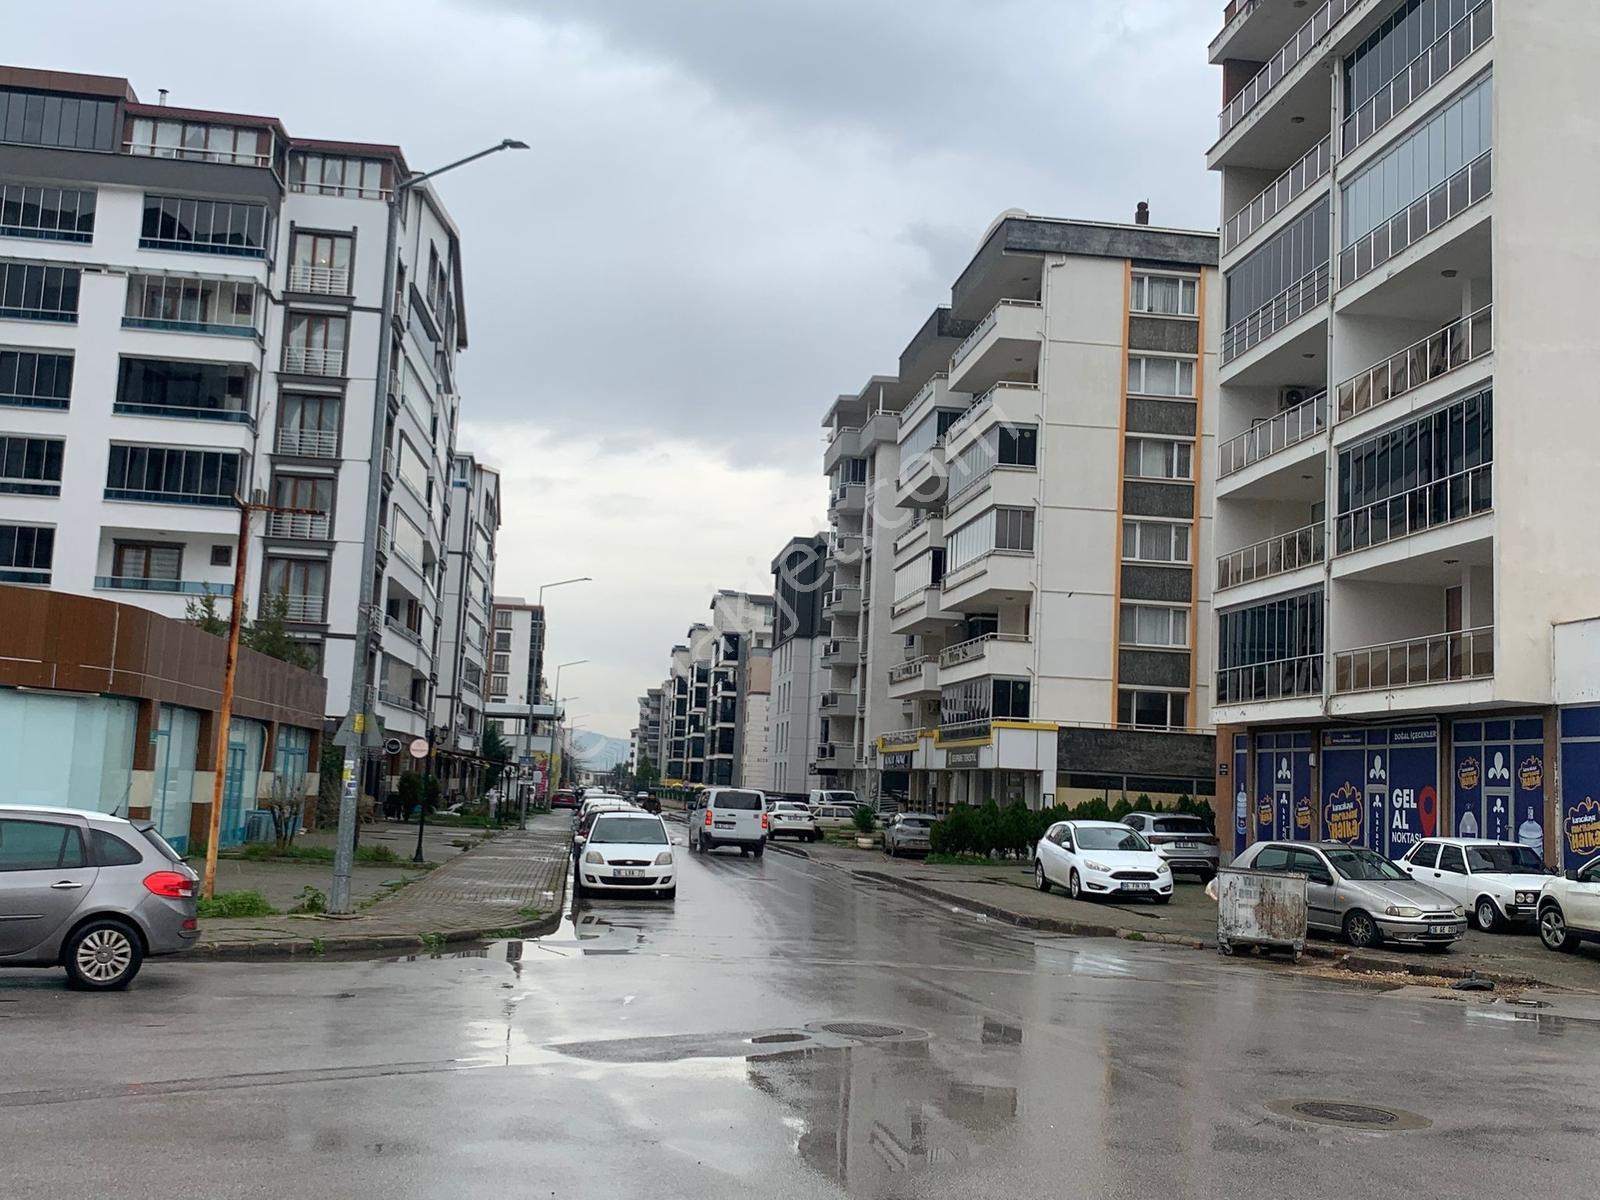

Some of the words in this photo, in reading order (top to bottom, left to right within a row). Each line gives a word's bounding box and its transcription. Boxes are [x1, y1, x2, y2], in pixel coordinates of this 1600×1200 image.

[1394, 732, 1410, 741] DOĞAL
[1392, 788, 1417, 809] GEL
[1392, 810, 1409, 829] AL
